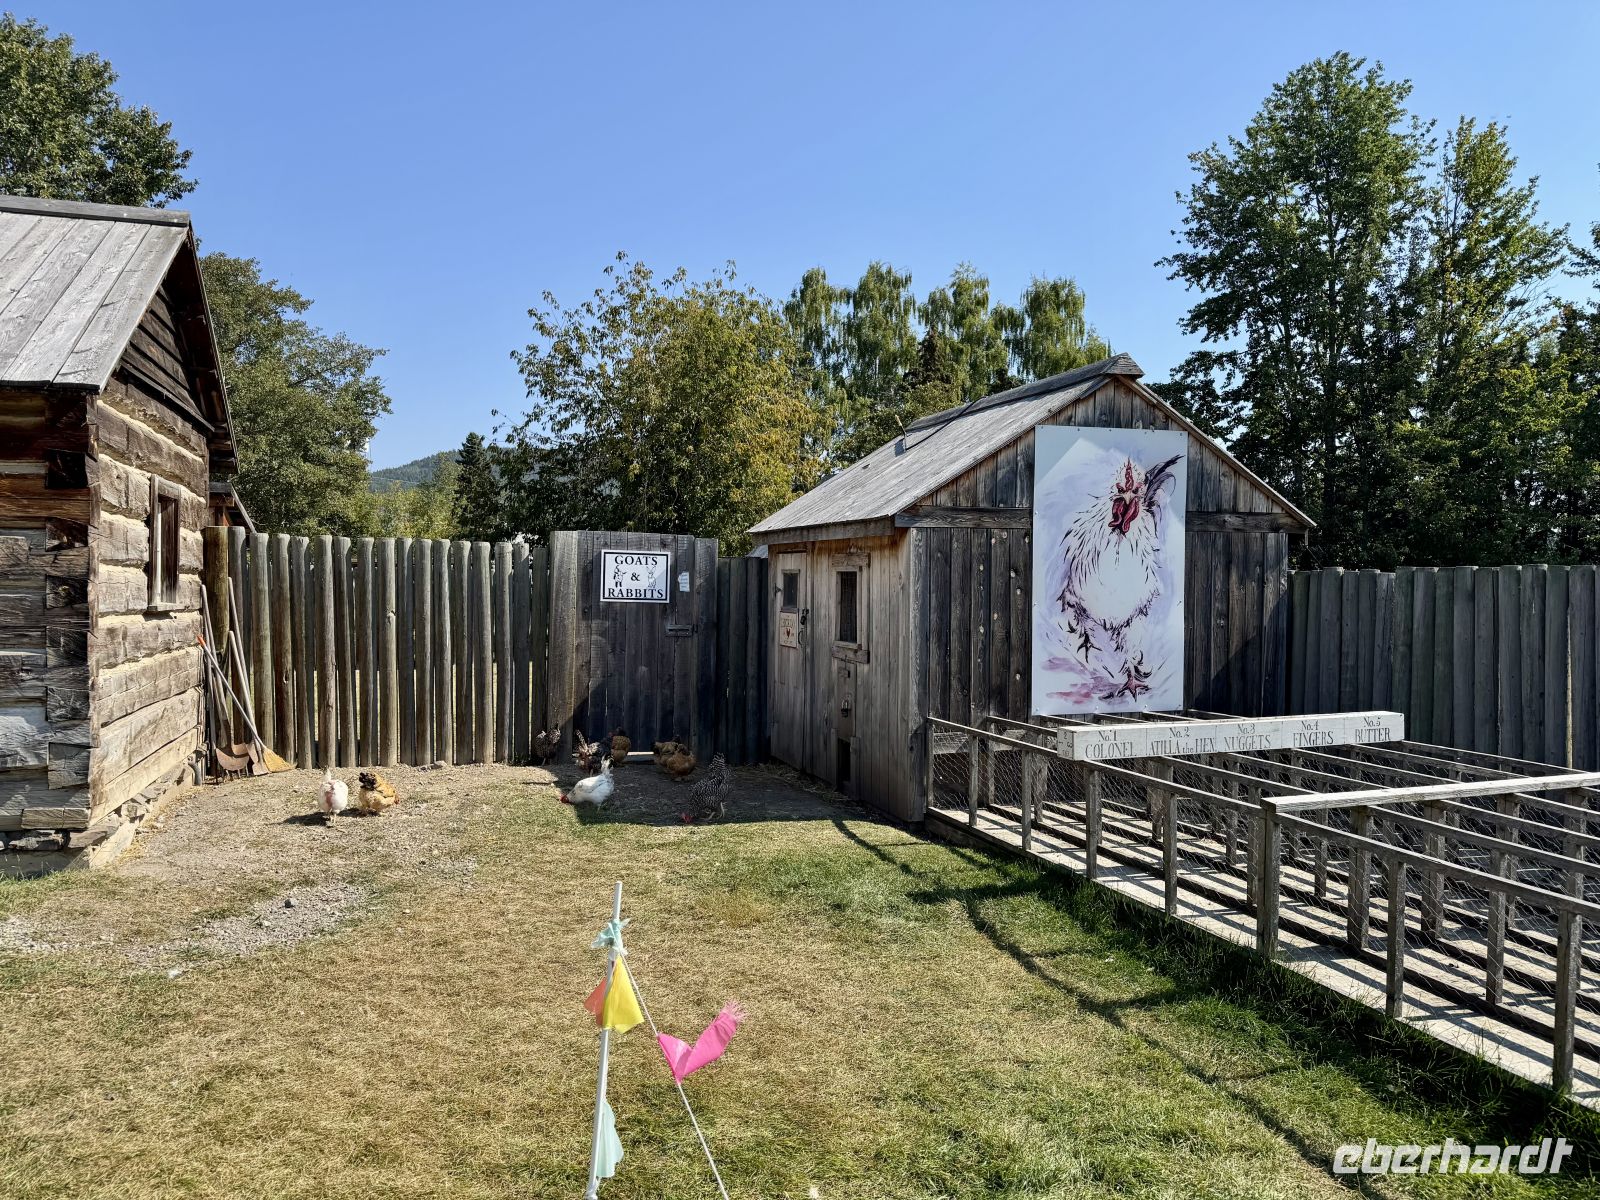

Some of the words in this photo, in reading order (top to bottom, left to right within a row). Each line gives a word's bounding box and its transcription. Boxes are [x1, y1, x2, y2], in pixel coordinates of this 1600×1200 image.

[614, 555, 658, 566] GOATS
[630, 572, 640, 581] &
[607, 587, 664, 599] RABBITS
[1224, 734, 1272, 751] NUGGETS
[1292, 731, 1334, 747] FINGERS
[1354, 727, 1391, 743] BUTTER
[1085, 741, 1137, 759] COLONEL
[1149, 739, 1180, 756] ATILLA
[1182, 742, 1194, 754] the
